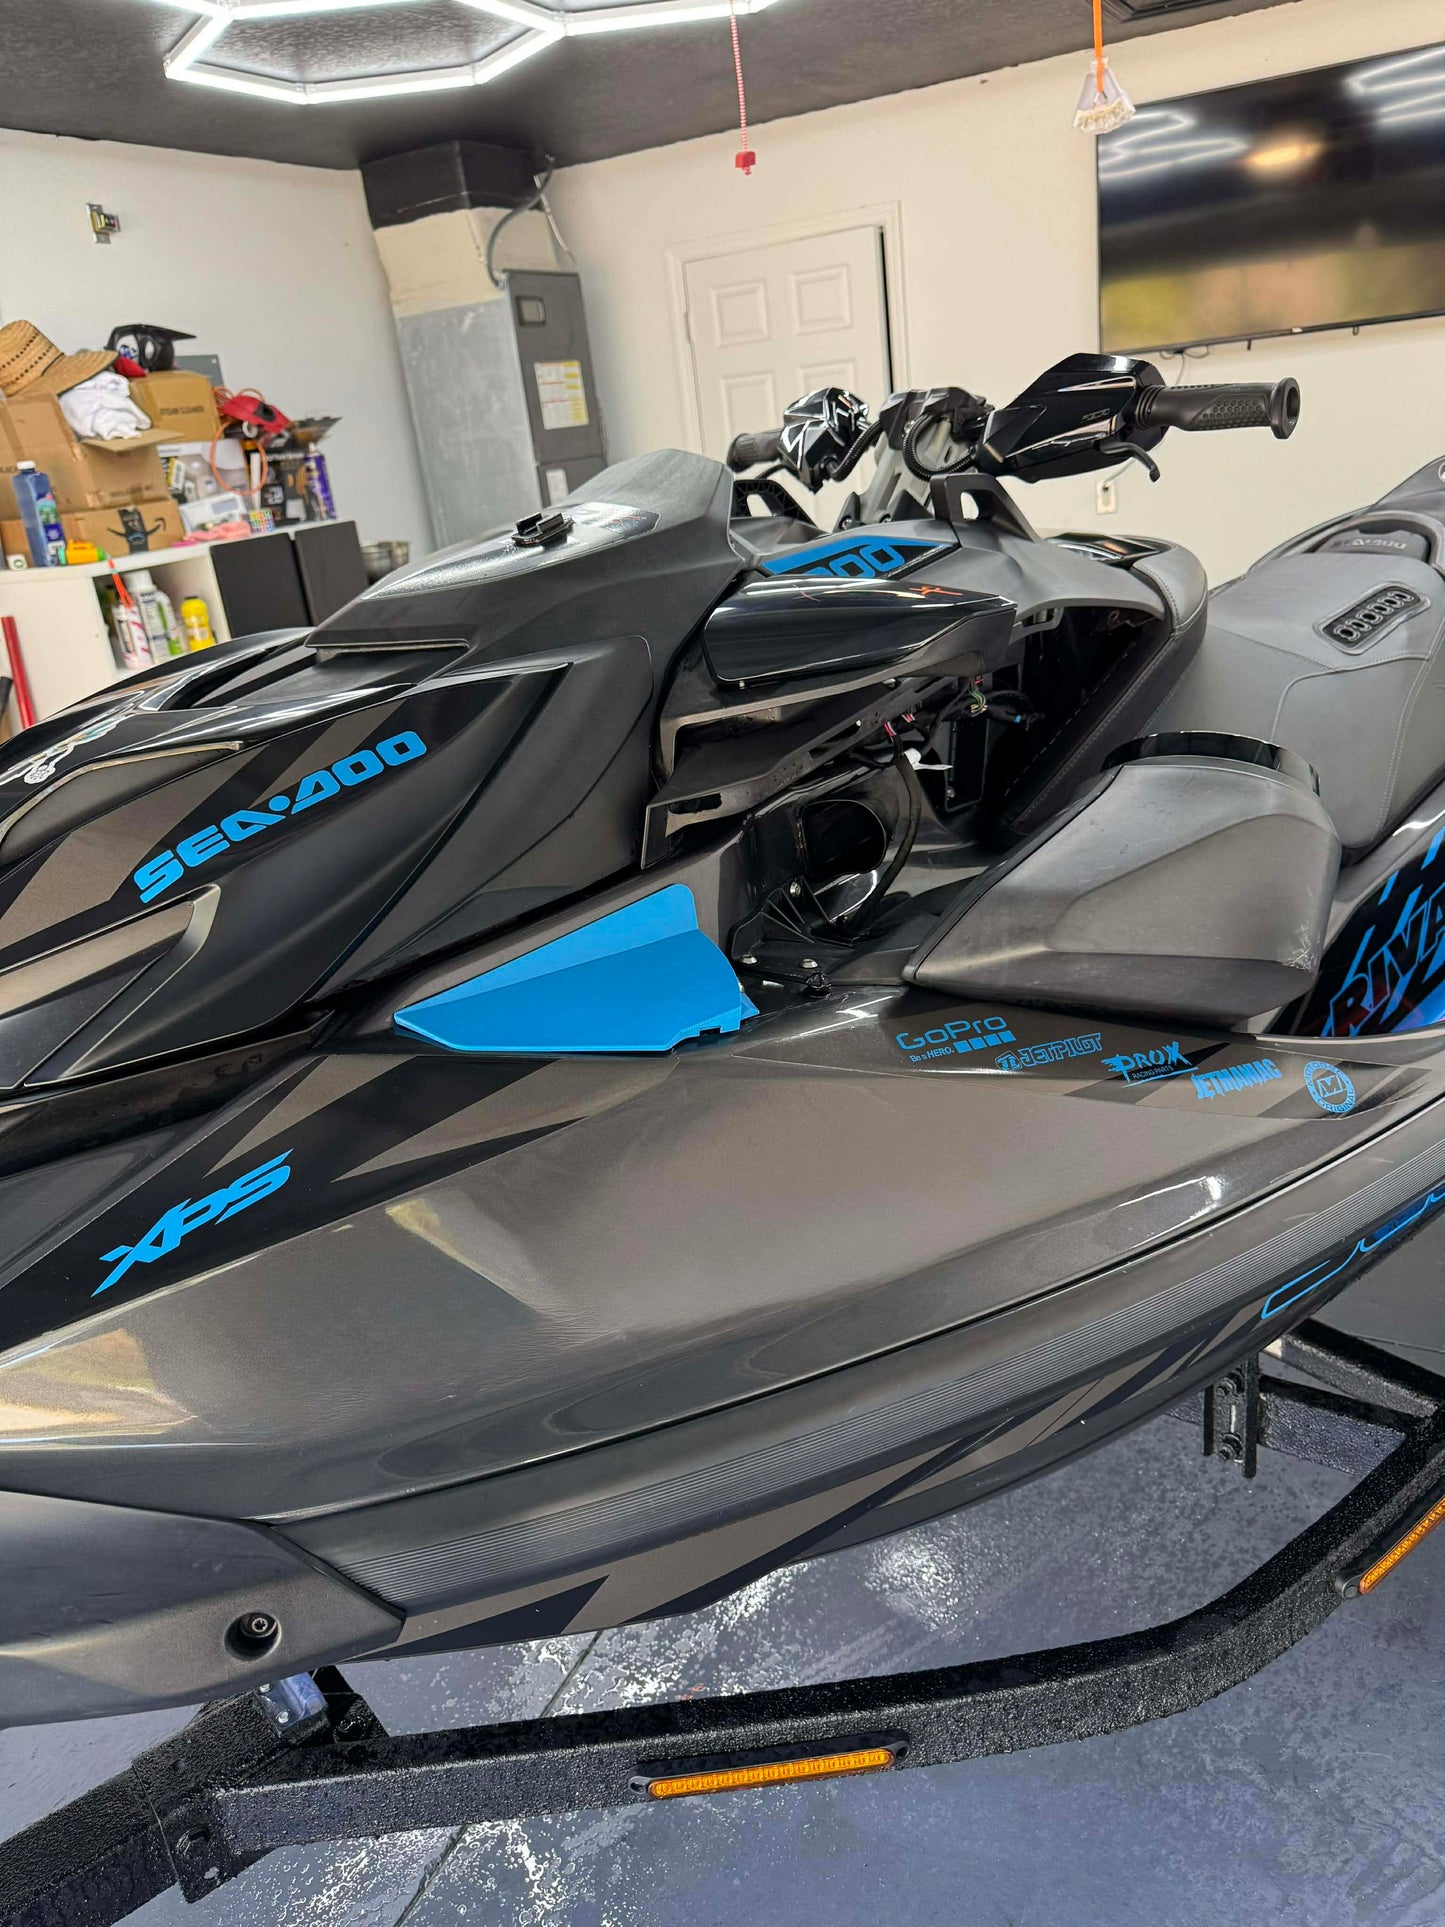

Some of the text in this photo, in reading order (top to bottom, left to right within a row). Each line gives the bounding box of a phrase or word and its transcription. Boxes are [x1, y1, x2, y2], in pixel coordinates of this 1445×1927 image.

[895, 1016, 1007, 1050] GoPro
[1017, 1032, 1102, 1067] JETPILOT
[1131, 1069, 1156, 1080] RACING
[90, 1148, 294, 1297] XPS
